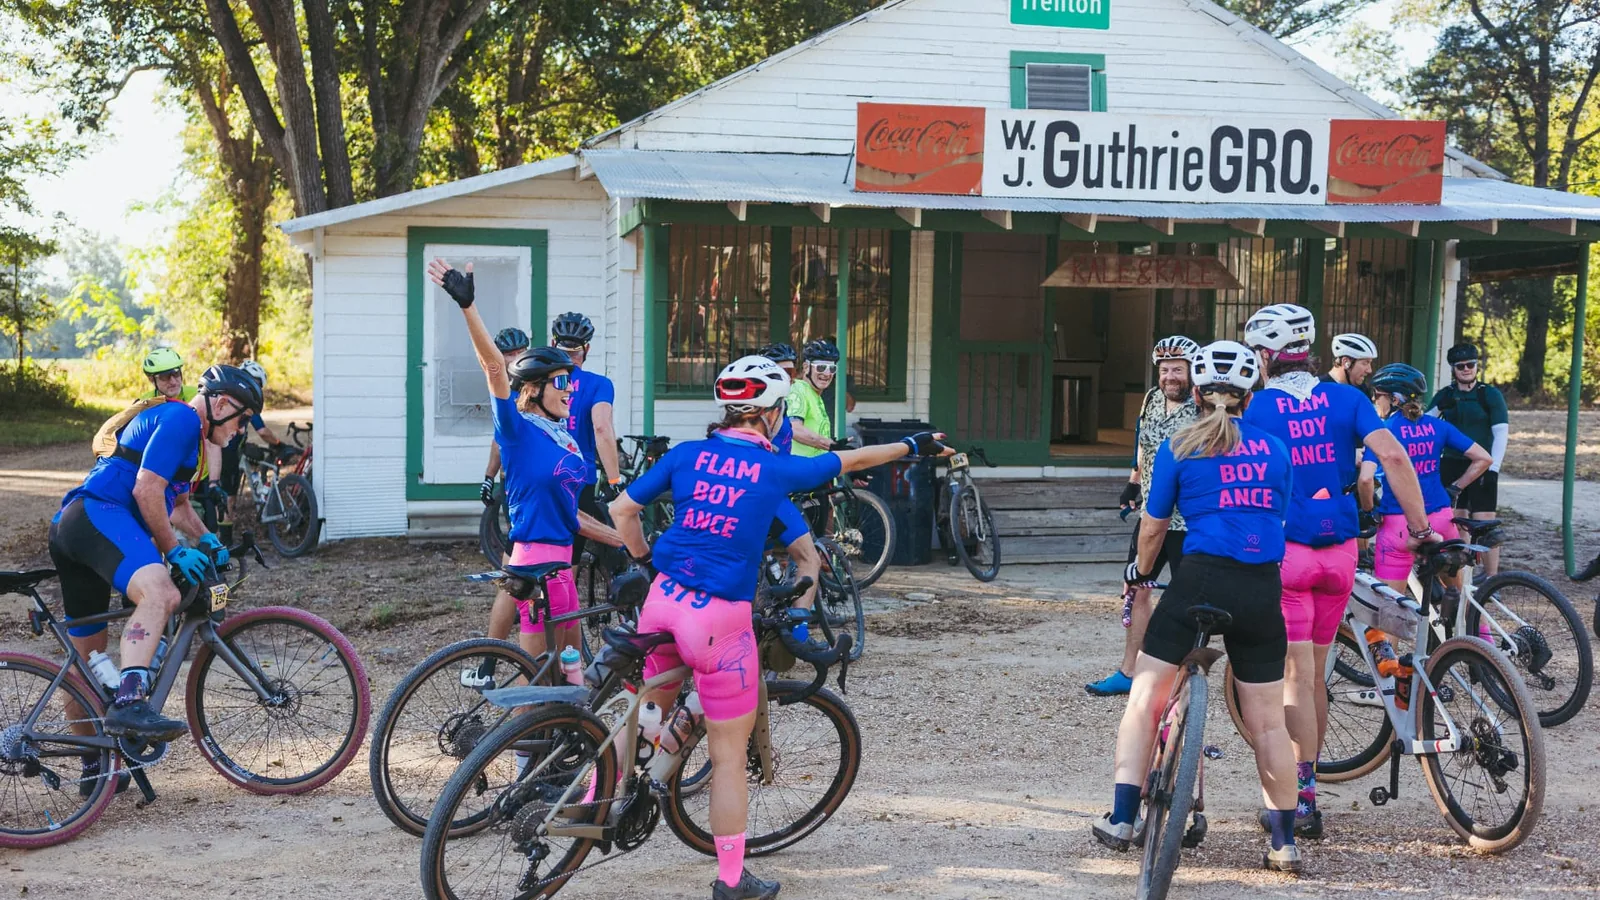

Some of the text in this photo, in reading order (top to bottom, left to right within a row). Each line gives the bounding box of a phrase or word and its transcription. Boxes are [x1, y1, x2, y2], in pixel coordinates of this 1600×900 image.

[1001, 119, 1036, 150] W.
[1043, 120, 1320, 195] Guthrie GRO.
[1003, 157, 1033, 187] J.
[1276, 392, 1330, 414] FLAM
[1288, 416, 1326, 439] BOY
[1400, 423, 1436, 439] FLAM
[1292, 443, 1336, 466] ANCE
[1408, 441, 1434, 457] BOY
[694, 451, 761, 483] FLAM
[1220, 462, 1268, 483] BOY
[1415, 460, 1437, 475] NCE
[693, 480, 747, 508] BOY
[1219, 488, 1273, 508] ANCE
[682, 508, 740, 538] ANCE
[660, 578, 712, 609] 479
